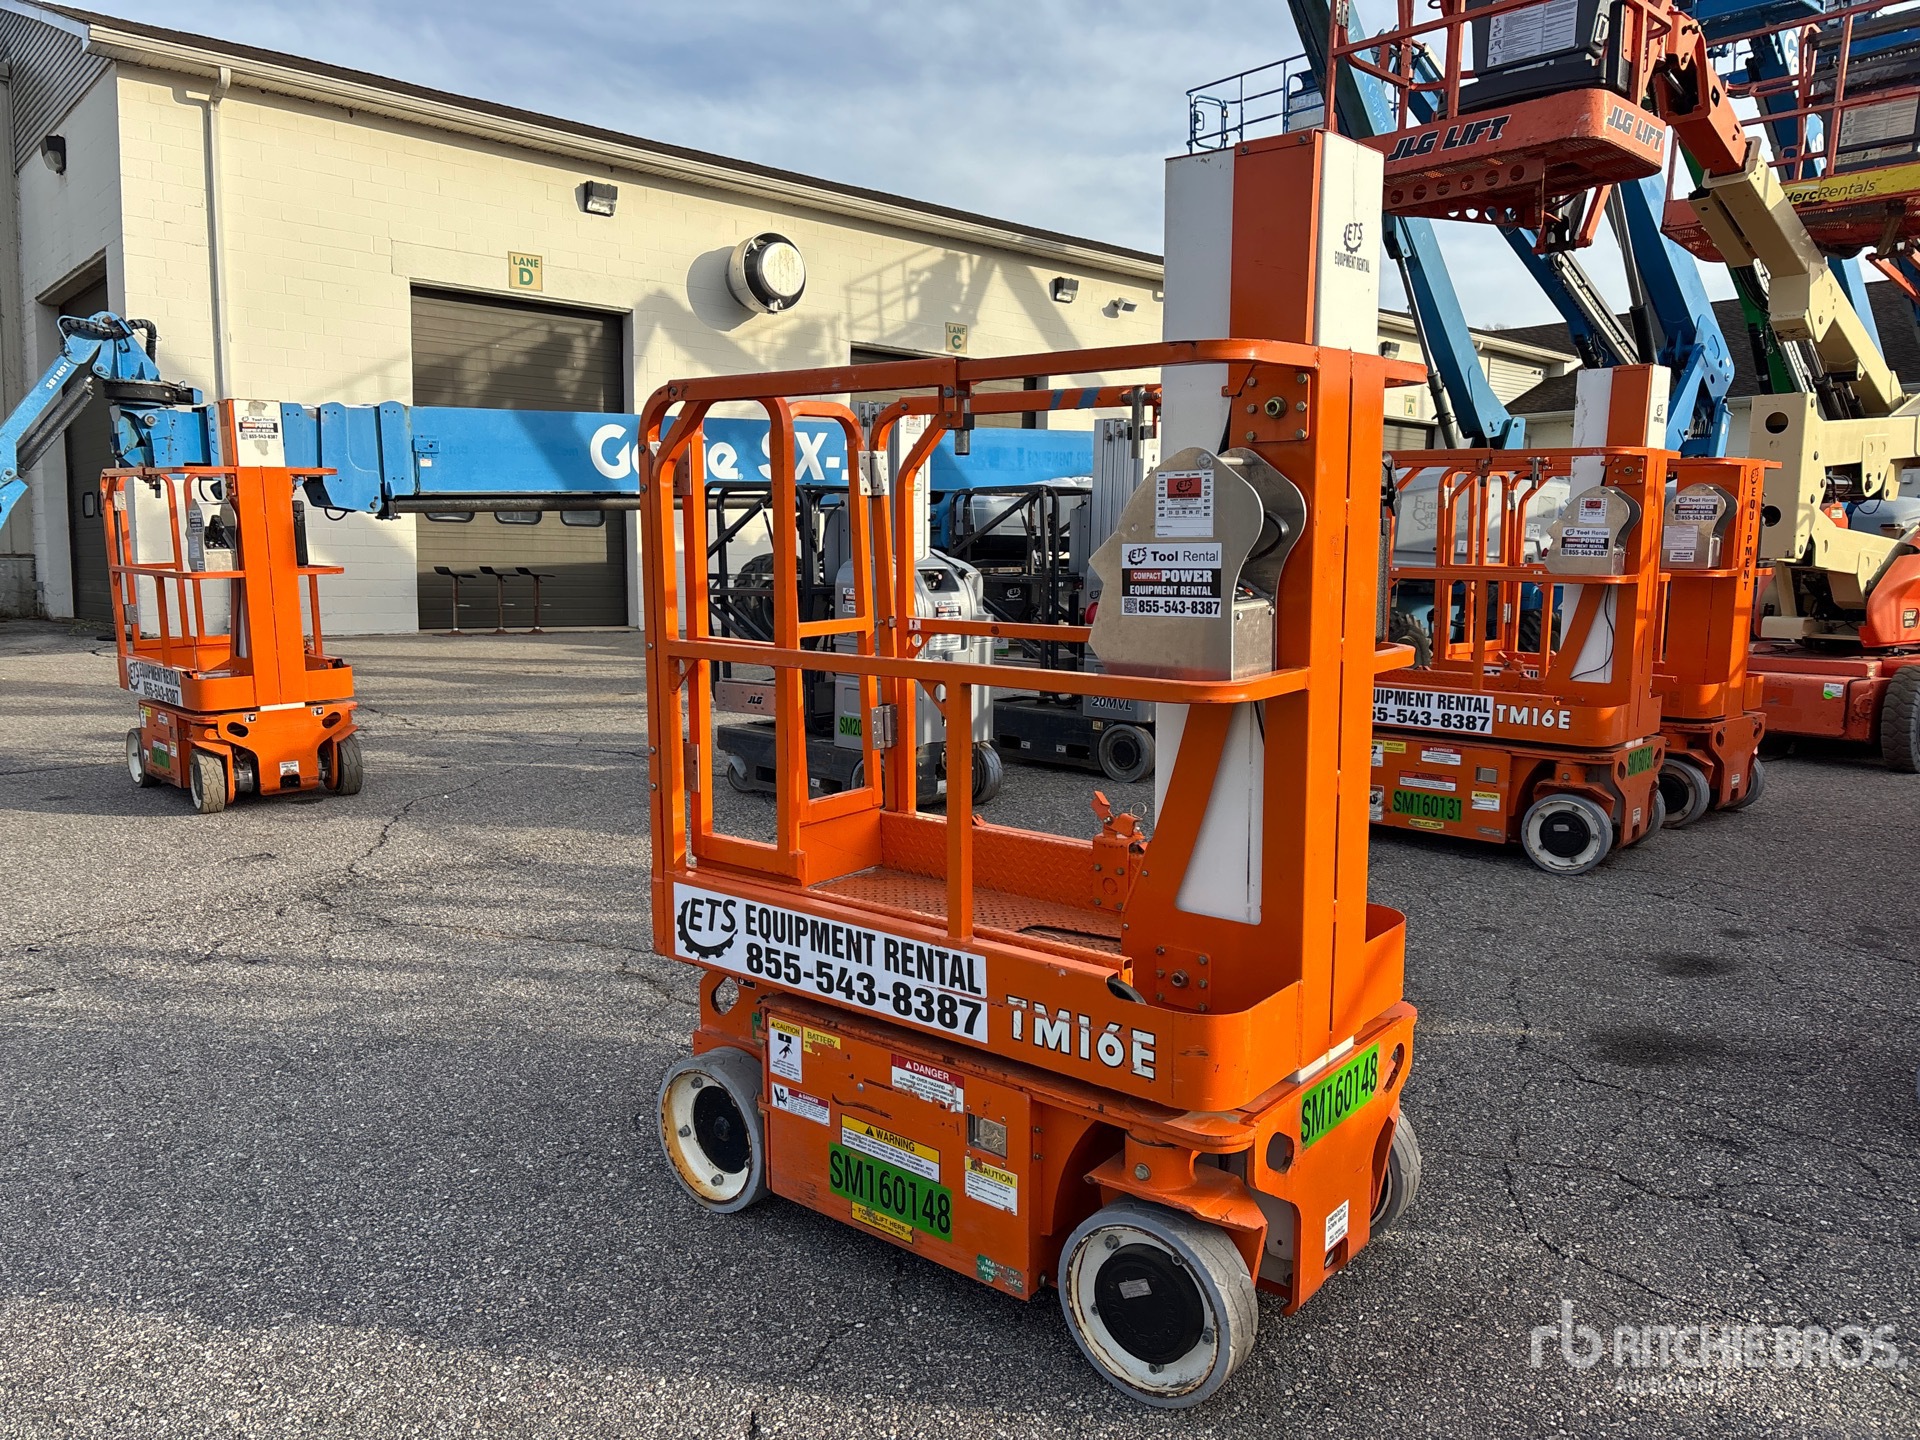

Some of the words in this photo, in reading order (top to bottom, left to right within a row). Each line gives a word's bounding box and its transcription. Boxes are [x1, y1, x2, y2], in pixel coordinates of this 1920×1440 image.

[1387, 130, 1439, 162] JLG
[1440, 114, 1511, 151] LIFT
[1607, 105, 1634, 134] JLG
[1635, 112, 1664, 152] LIFT
[512, 256, 539, 268] LANE
[519, 267, 534, 286] D
[948, 326, 966, 335] LANE
[951, 335, 962, 349] C
[1407, 404, 1414, 414] A
[1743, 487, 1756, 591] EQUIPMENT
[1151, 551, 1178, 562] Tool
[1183, 551, 1219, 562] Rental
[1133, 572, 1161, 580] COMPACT
[1162, 570, 1212, 582] POWER
[1130, 585, 1178, 595] EQUIPMENT
[1180, 585, 1212, 596] RENTAL
[1138, 600, 1220, 615] 855-543-8387
[140, 661, 163, 683] EQUIPMENT
[163, 668, 180, 688] RENTAL
[748, 696, 762, 704] JLG
[1091, 695, 1133, 711] 20MVL
[1373, 688, 1436, 708] UIPMENT
[1437, 694, 1490, 714] RENTAL
[1372, 708, 1490, 732] 55-543-8387
[1495, 704, 1572, 730] TM16E
[1393, 791, 1462, 820] SM160131
[688, 898, 737, 933] ETS
[745, 903, 876, 966] EQUIPMENT
[884, 937, 982, 995] RENTAL
[746, 943, 982, 1035] 855-543-8387
[776, 1023, 800, 1035] CAUTION
[1006, 994, 1156, 1080] TM16E
[807, 1031, 836, 1047] BATTERY
[913, 1062, 950, 1082] DANGER
[802, 1094, 819, 1104] DANGER
[1301, 1051, 1378, 1143] SM160148
[876, 1129, 915, 1152] WARNING
[830, 1150, 950, 1234] SM160148
[889, 1219, 906, 1232] HERE
